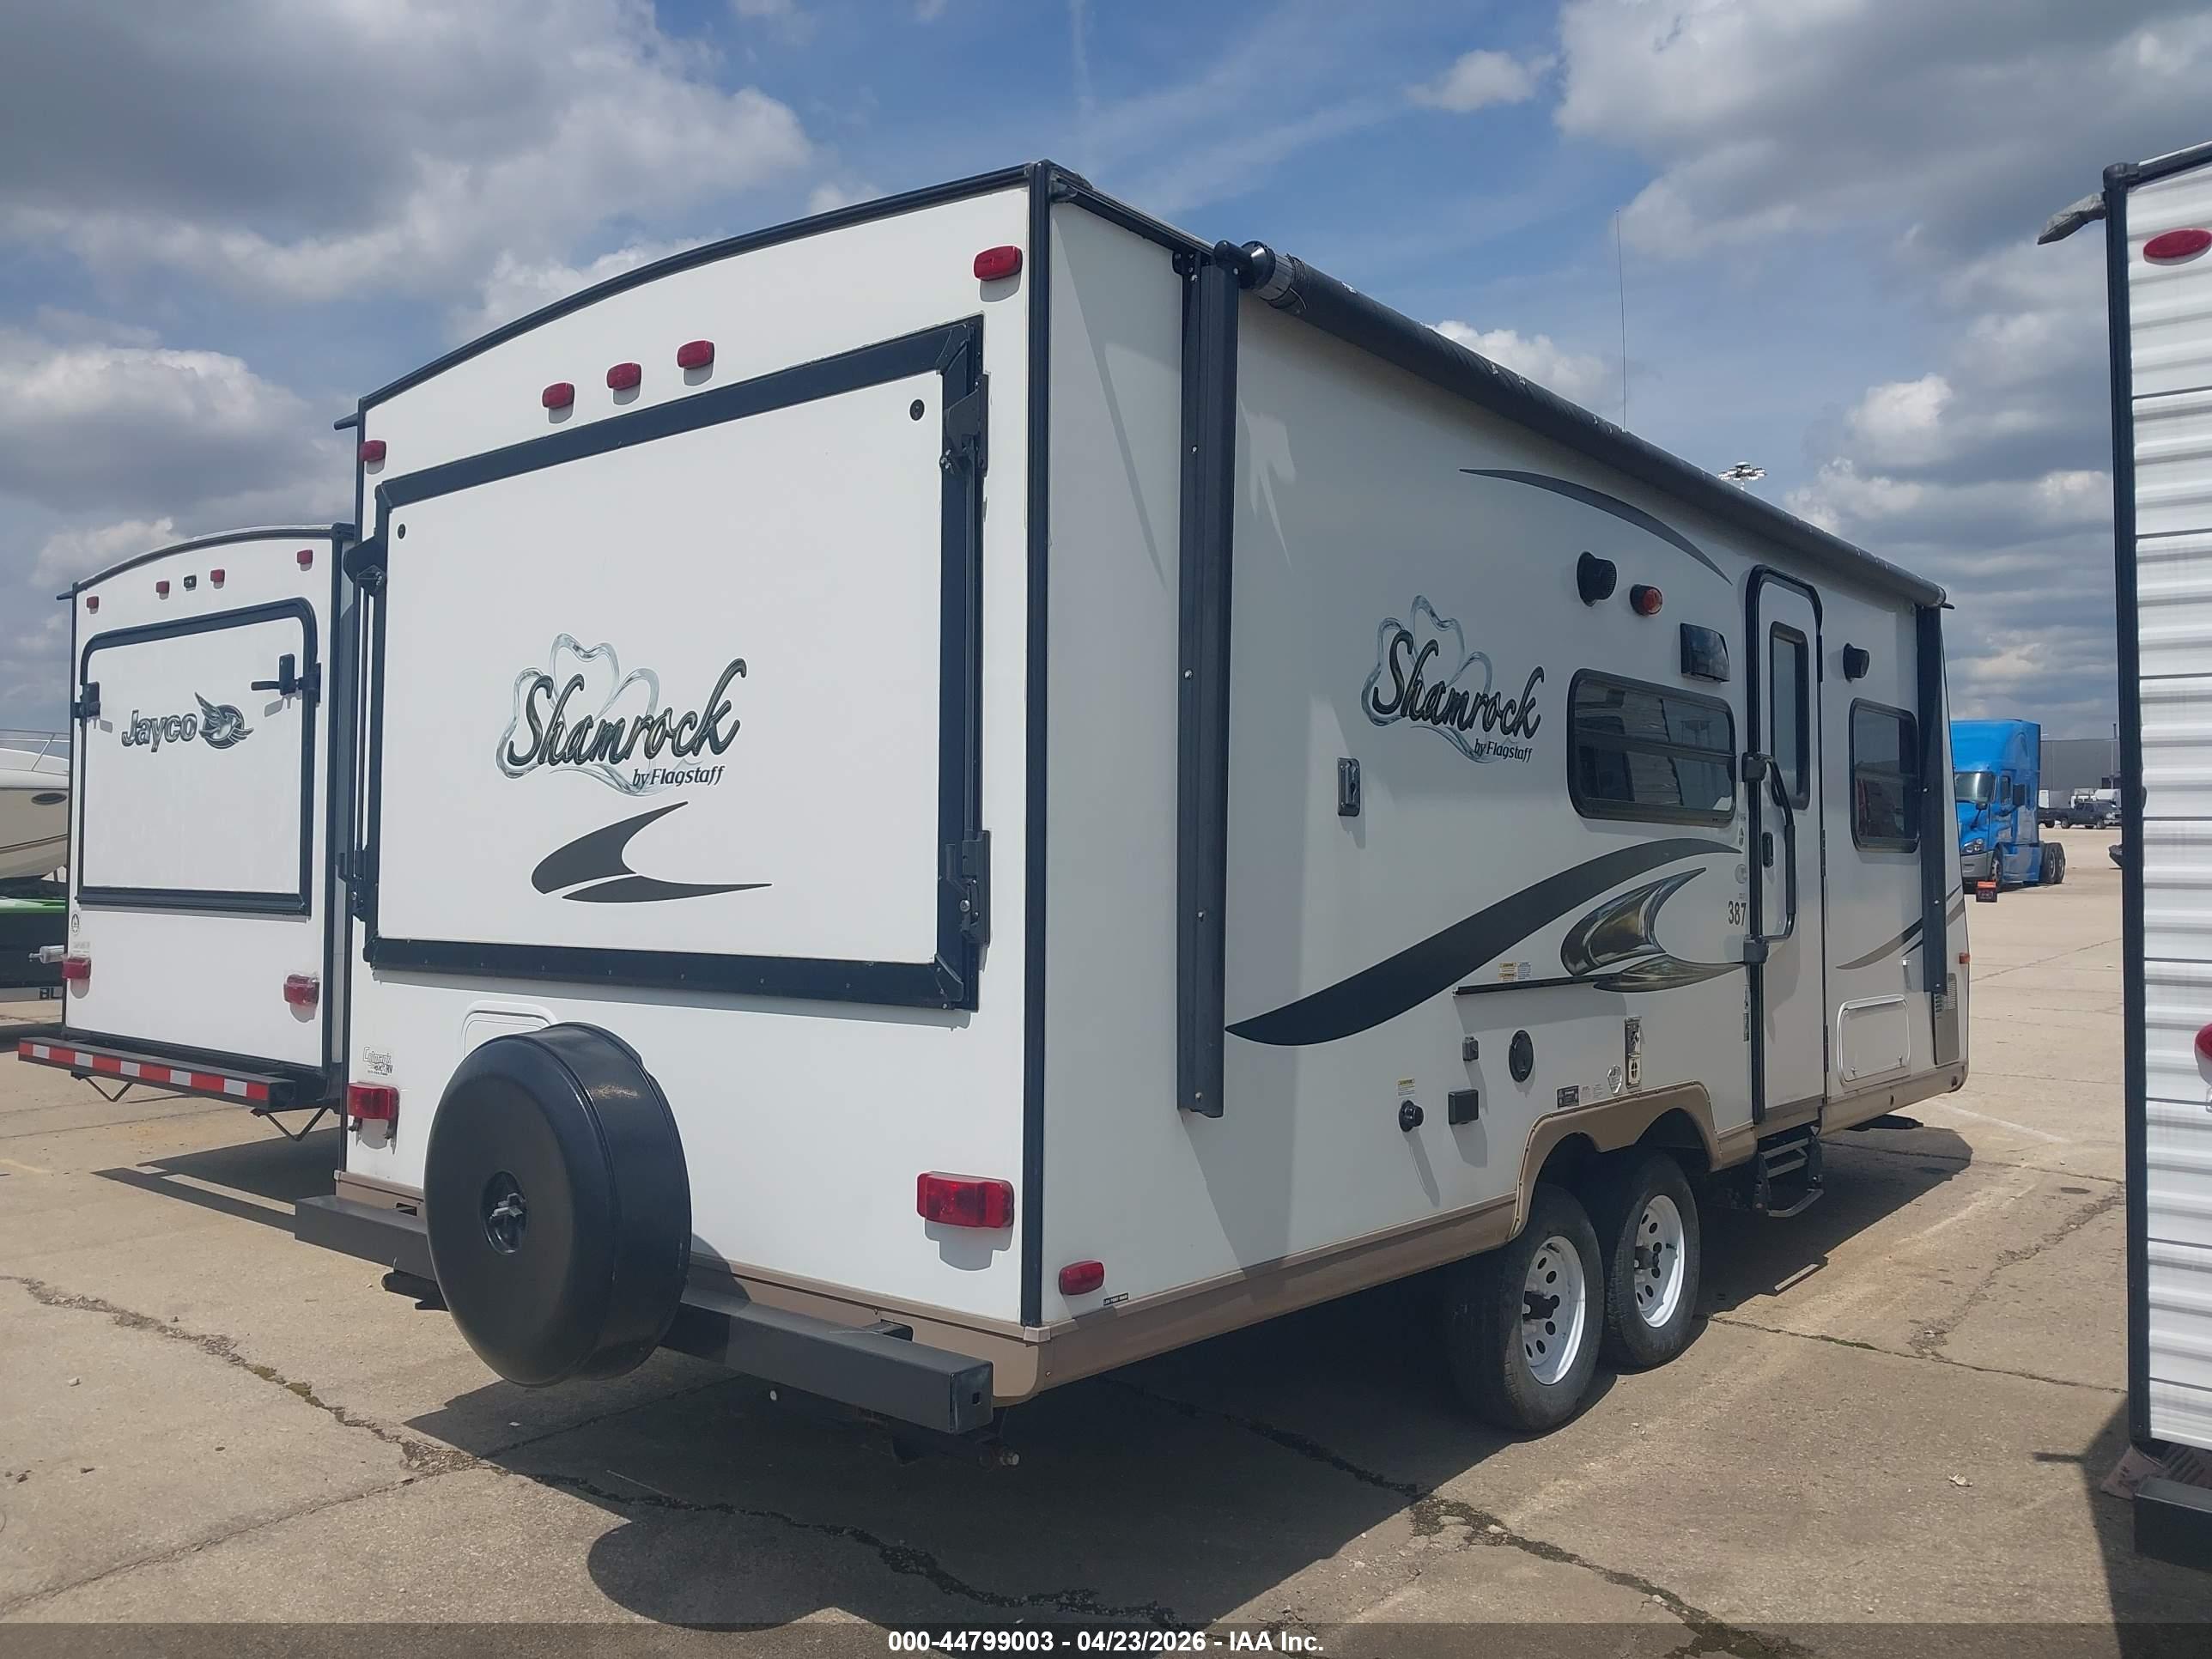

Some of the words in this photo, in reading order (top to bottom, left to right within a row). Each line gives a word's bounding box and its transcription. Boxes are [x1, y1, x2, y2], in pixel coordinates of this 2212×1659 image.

[1372, 629, 1545, 739] Shamrock
[507, 657, 747, 767] Shamrock
[121, 709, 198, 753] Jayco
[1474, 738, 1486, 757] by
[1486, 740, 1533, 763] Flagstaff
[632, 768, 651, 788] by
[650, 765, 726, 787] Flagstaff
[1728, 900, 1747, 927] 387
